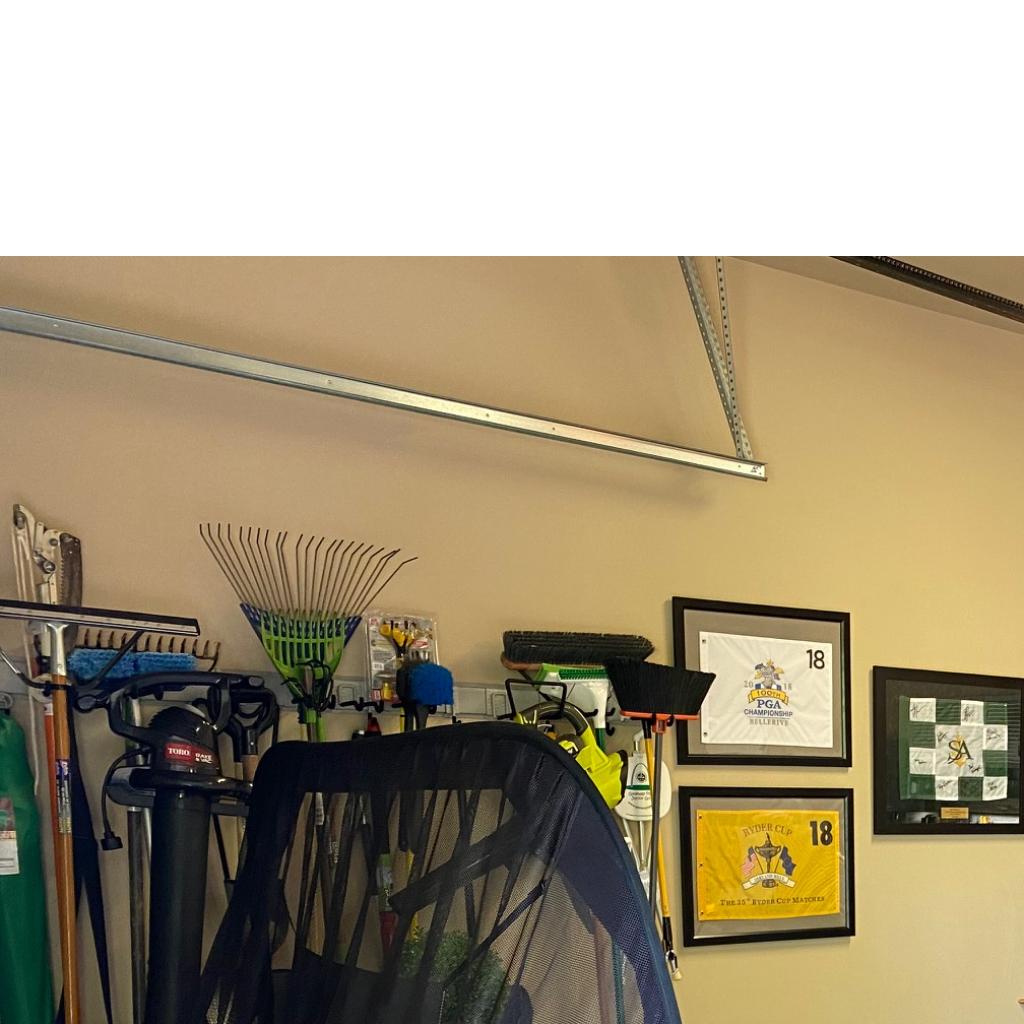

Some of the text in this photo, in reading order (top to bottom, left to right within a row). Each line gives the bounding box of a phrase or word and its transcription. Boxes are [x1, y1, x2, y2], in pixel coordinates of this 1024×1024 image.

[806, 649, 826, 670] 18
[757, 700, 781, 709] PGA
[743, 709, 793, 718] CHAMPIONSHIP
[168, 747, 190, 756] TORO
[742, 823, 774, 838] RYDER
[809, 820, 833, 846] 18
[776, 897, 791, 905] CUP
[792, 896, 825, 904] MATCHES
